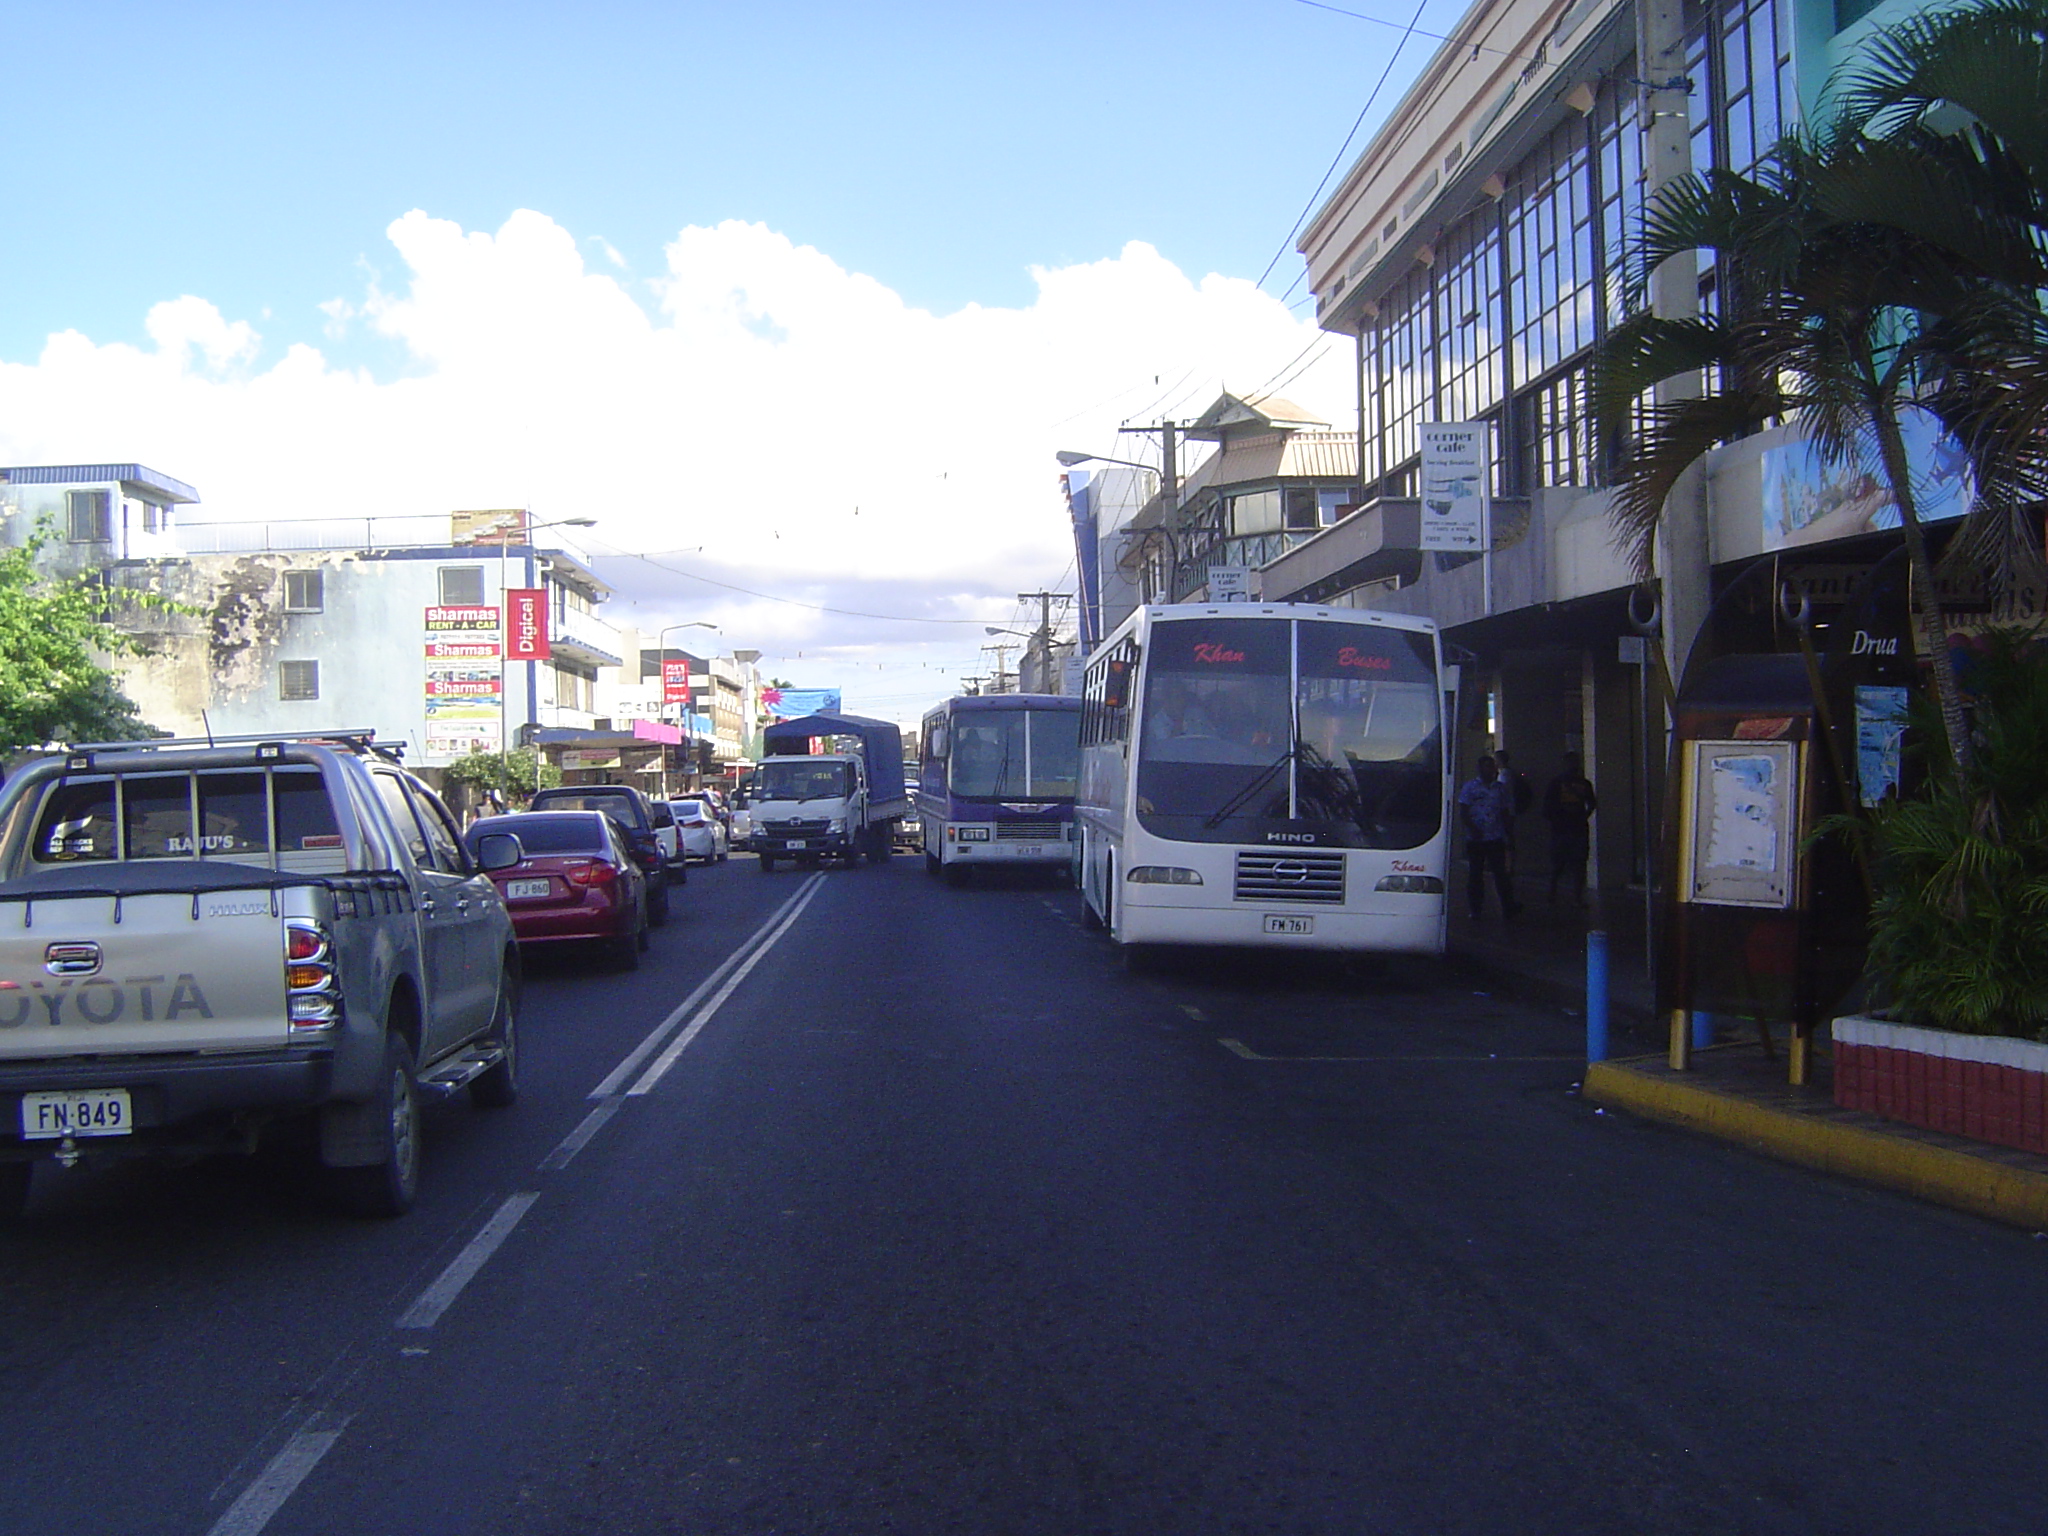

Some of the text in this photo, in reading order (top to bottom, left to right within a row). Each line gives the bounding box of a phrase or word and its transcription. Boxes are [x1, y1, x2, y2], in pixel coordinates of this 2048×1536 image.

[428, 608, 497, 621] Sharmas
[429, 621, 455, 630] RENT
[476, 621, 497, 629] CAR
[519, 598, 537, 652] Digicel
[1850, 630, 1897, 655] Drua
[434, 645, 493, 656] Sharmas
[1194, 643, 1392, 670] Khan Buses
[434, 682, 493, 693] Sharmas
[1267, 832, 1316, 843] HINO
[1391, 860, 1427, 872] Khans
[209, 903, 268, 917] HILUX
